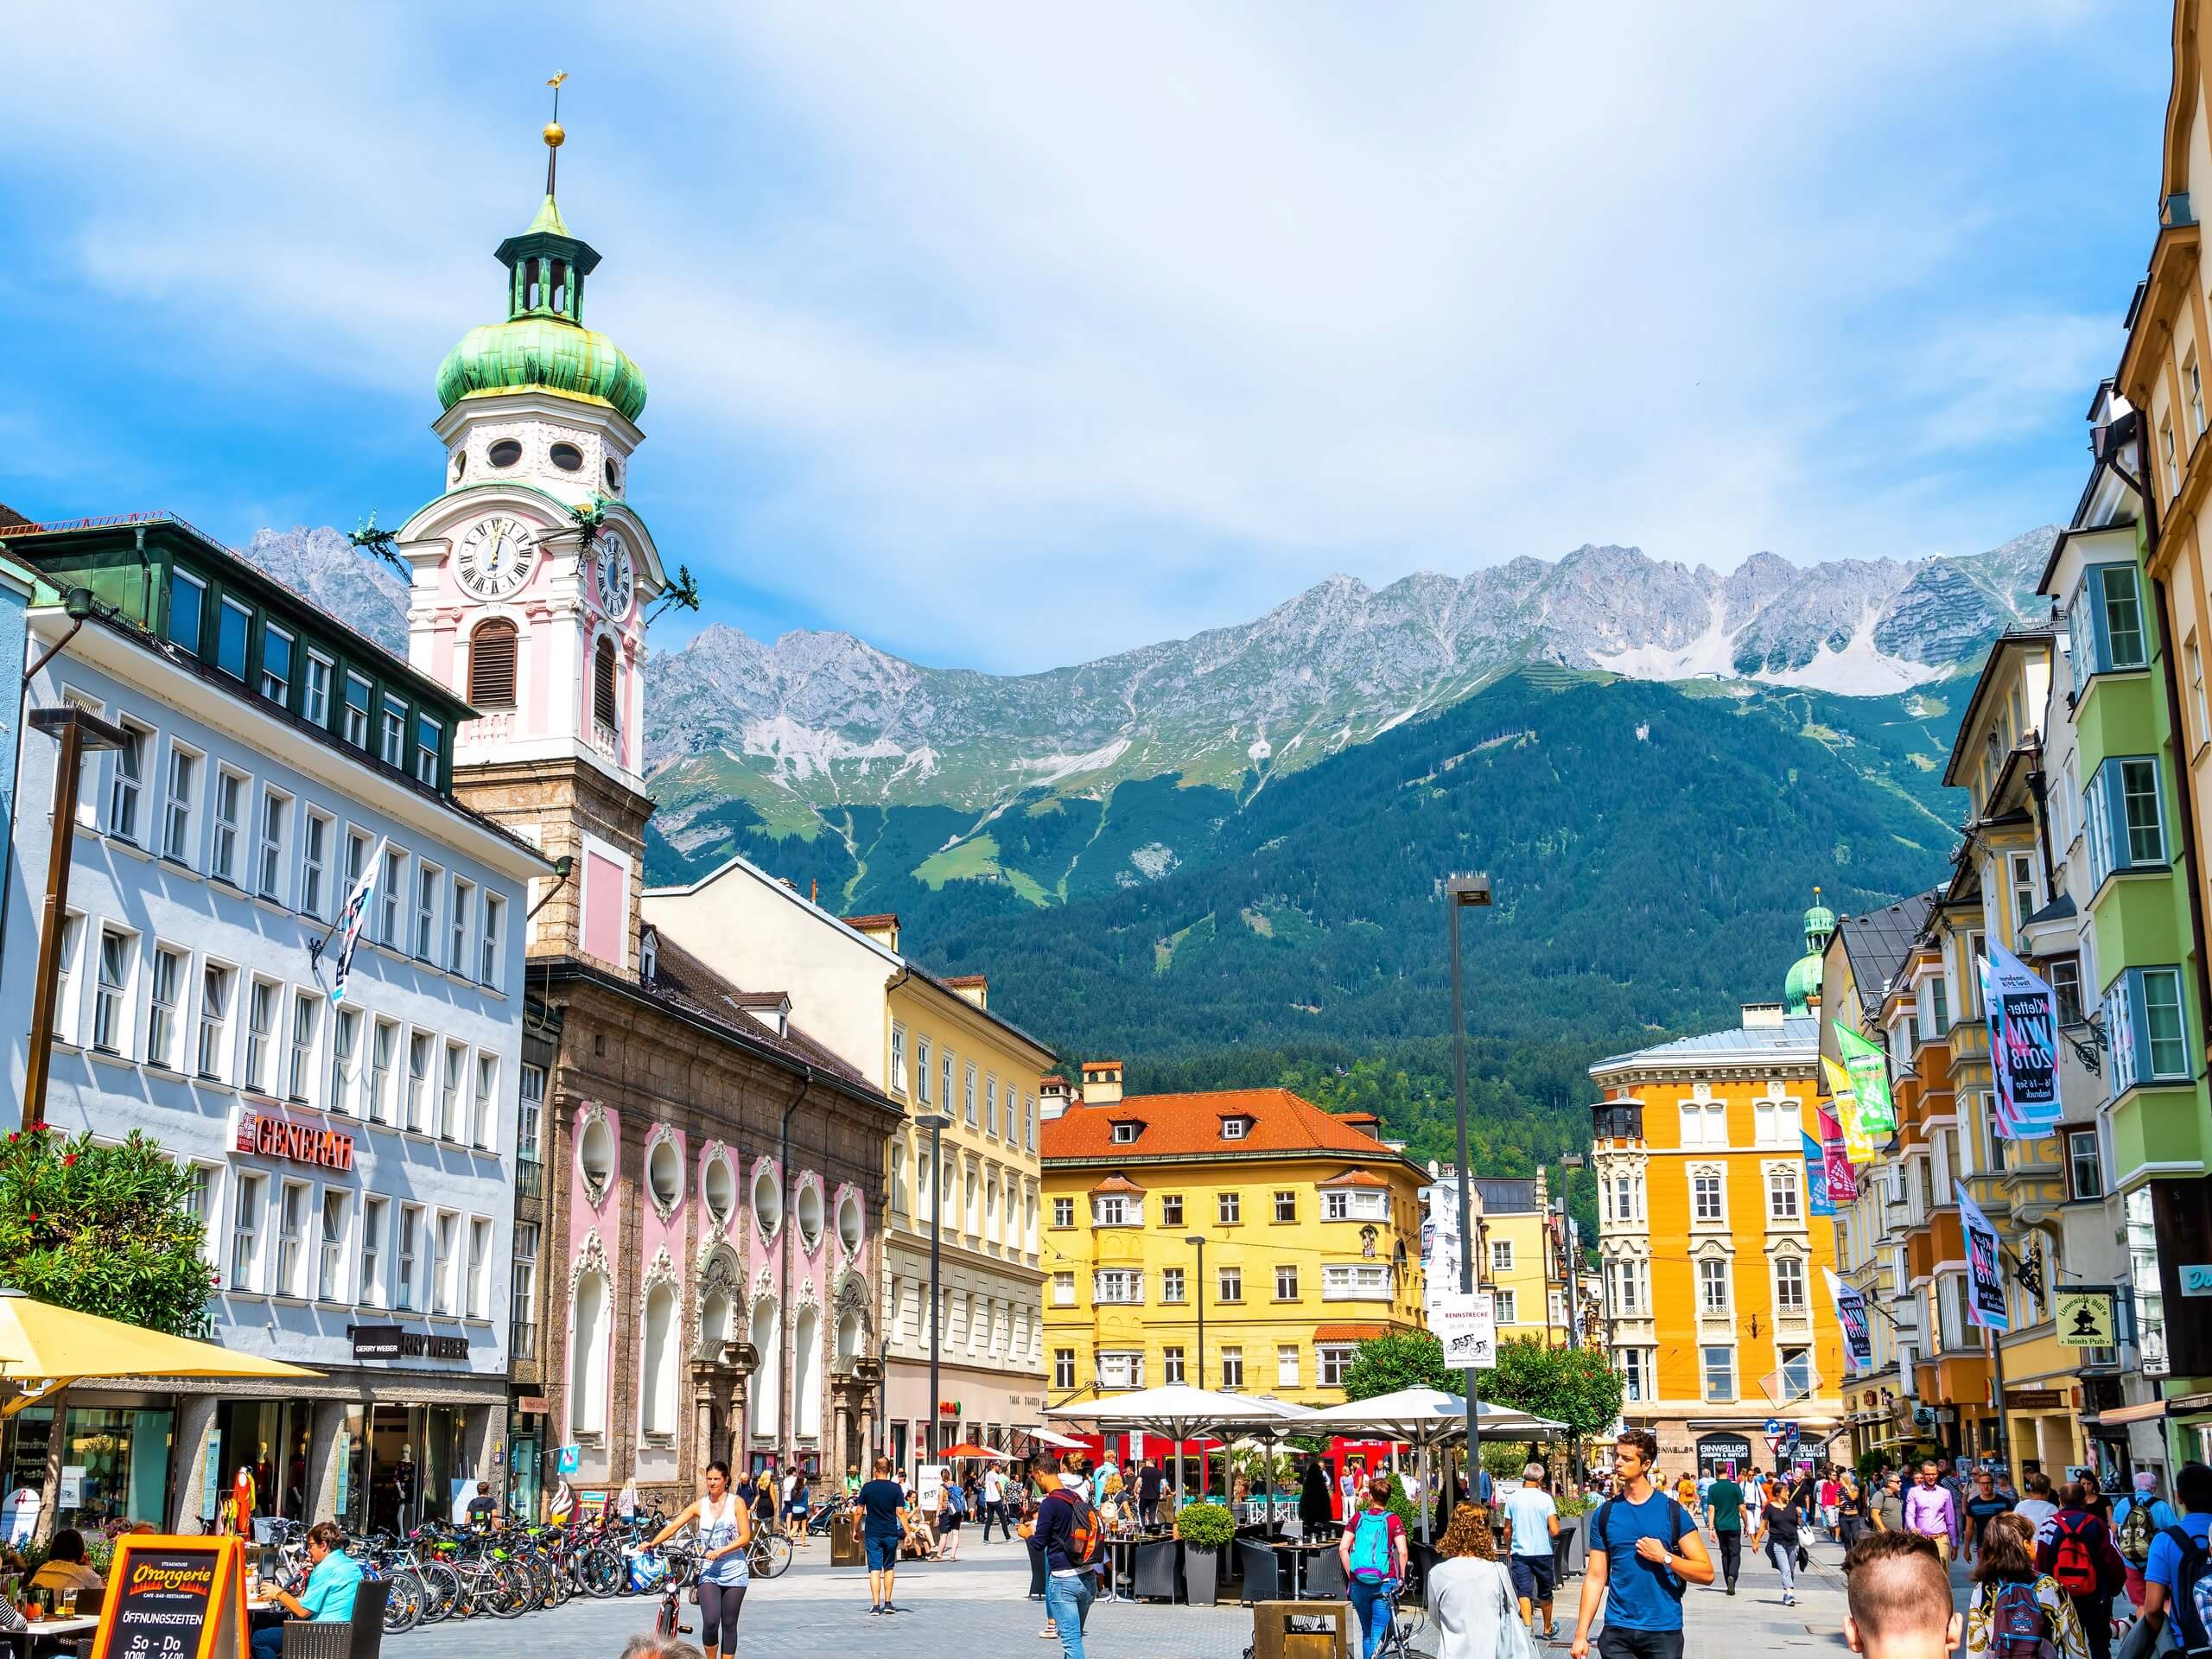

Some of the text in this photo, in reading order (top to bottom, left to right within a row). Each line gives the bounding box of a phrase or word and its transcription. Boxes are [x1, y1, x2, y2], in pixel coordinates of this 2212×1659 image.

[257, 1116, 354, 1171] GENERALI
[2058, 1296, 2090, 1317] Limerick
[428, 1334, 469, 1360] WEBER
[133, 1563, 211, 1589] Orangerie
[123, 1611, 204, 1625] ÖFFNUNGSZEITEN
[131, 1635, 149, 1649] So
[162, 1636, 181, 1650] Do
